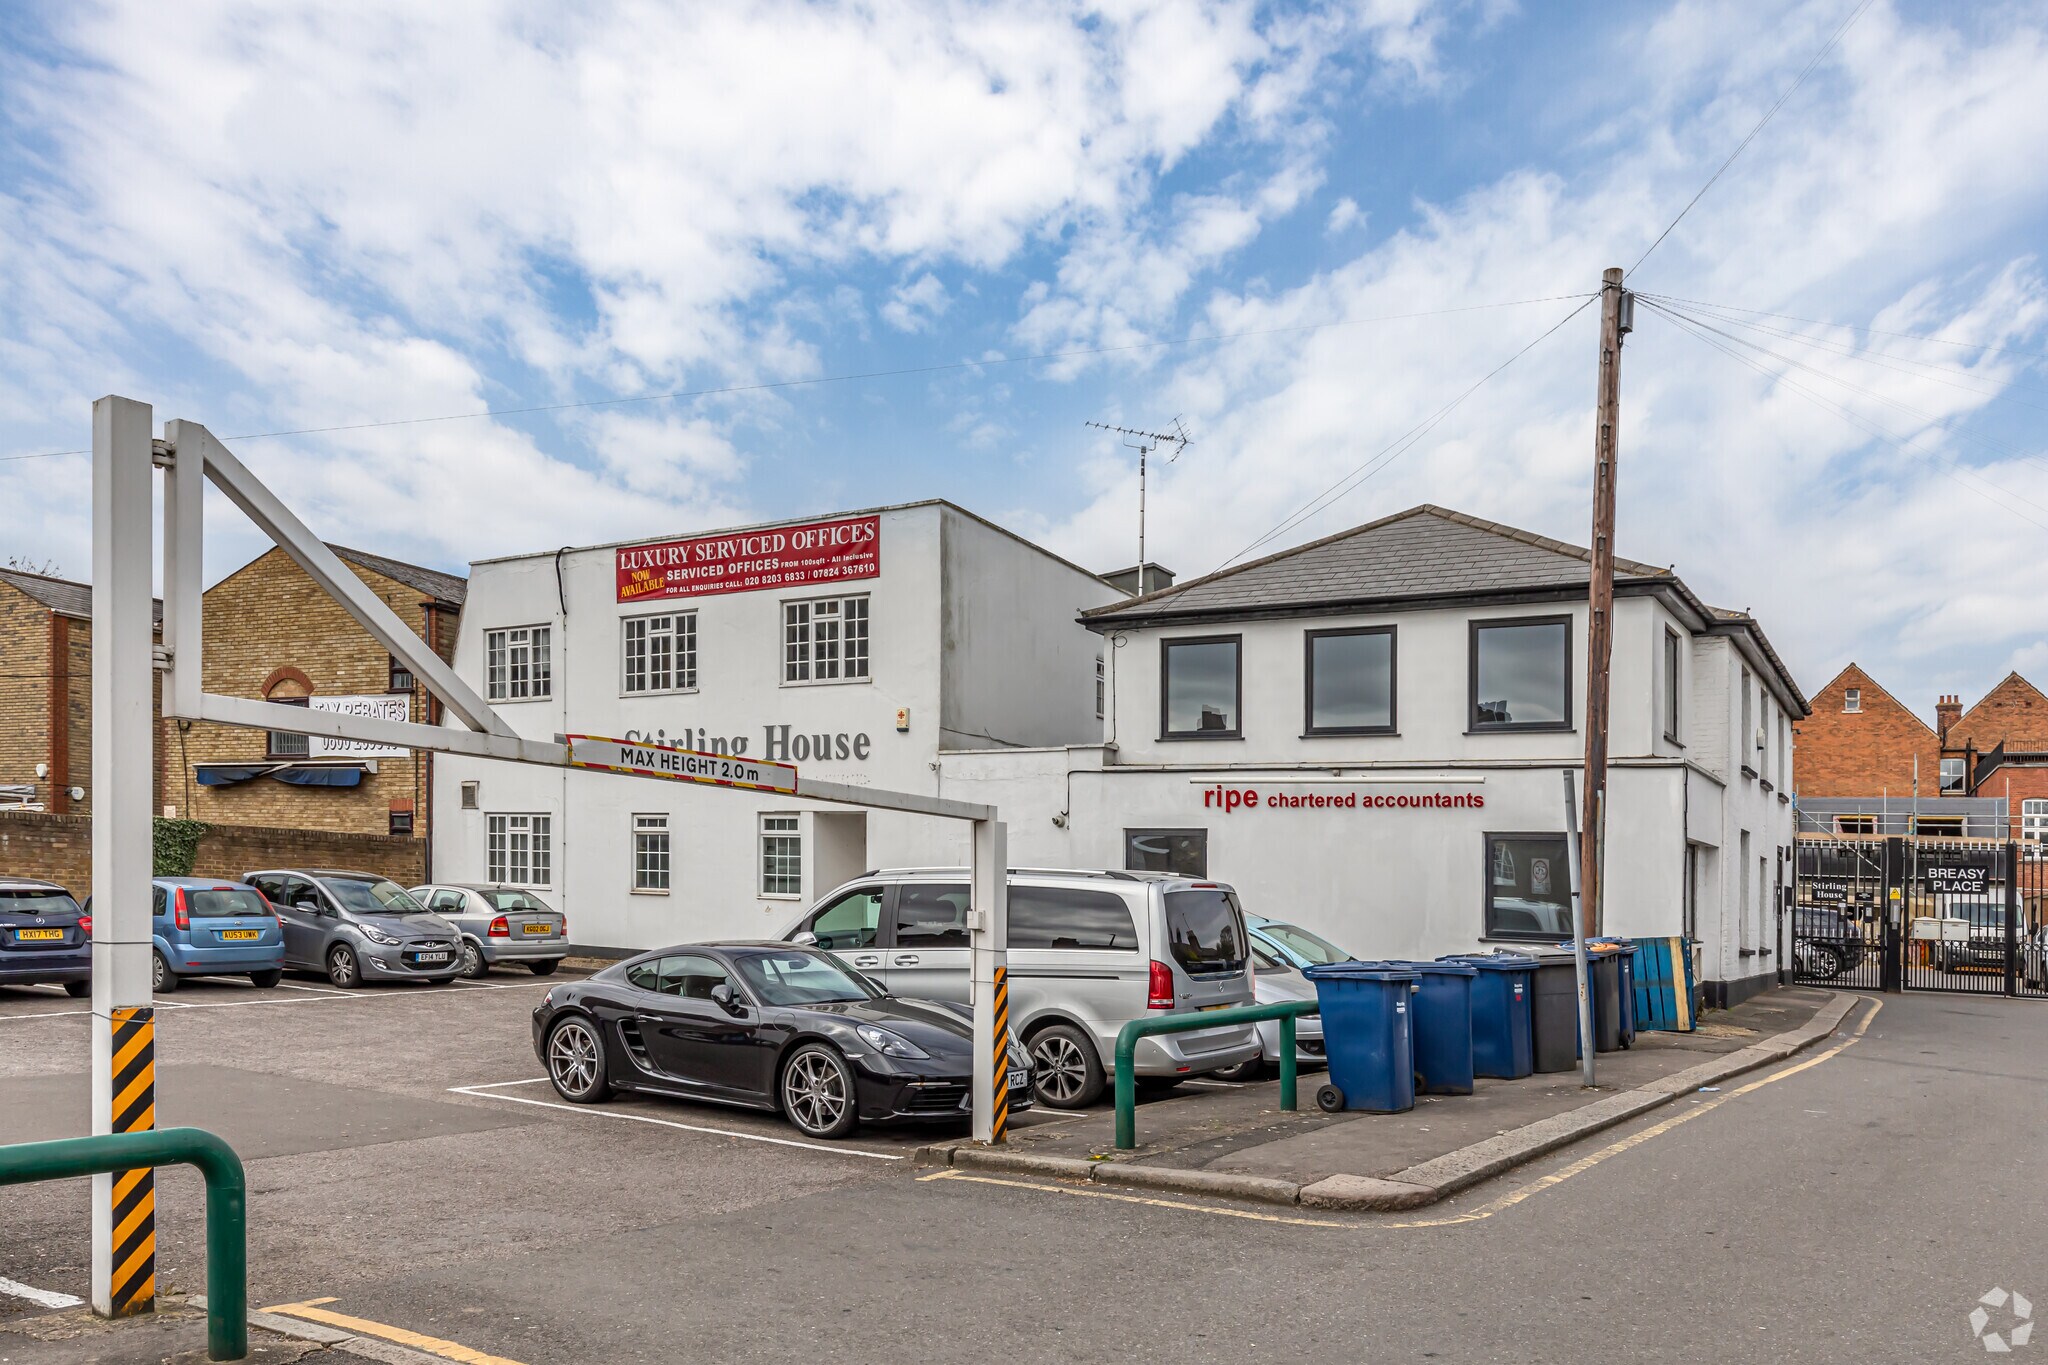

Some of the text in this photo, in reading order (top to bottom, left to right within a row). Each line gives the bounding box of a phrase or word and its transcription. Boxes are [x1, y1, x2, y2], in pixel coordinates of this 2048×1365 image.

[620, 522, 875, 570] LUXURY SERVICED OFFICES
[666, 564, 724, 581] SERVICED
[728, 558, 779, 575] OFFICES
[780, 560, 799, 568] FROM
[800, 557, 826, 567] 100sqft
[831, 555, 841, 563] All
[843, 551, 874, 561] Inclusive
[631, 568, 651, 584] NOW
[665, 586, 678, 594] FOR
[679, 585, 690, 593] ALL
[692, 582, 724, 592] ENQUIRIES
[744, 576, 759, 586] 020
[761, 573, 782, 584] 8203
[784, 571, 805, 582] 6833
[812, 567, 839, 579] 07824
[842, 562, 875, 576] 367610
[621, 577, 665, 598] AVAILABLE
[763, 724, 871, 761] House
[621, 747, 655, 768] MAX
[660, 753, 717, 776] HEIGHT
[1204, 785, 1485, 813] ripe chartered accountants
[1928, 868, 1986, 880] BREASY
[1812, 882, 1847, 891] Stirling
[1817, 890, 1843, 899] House
[1933, 881, 1982, 892] PLACE
[22, 930, 59, 938] HX17 THG
[224, 931, 242, 939] AU53
[1010, 1073, 1024, 1086] RCZ
